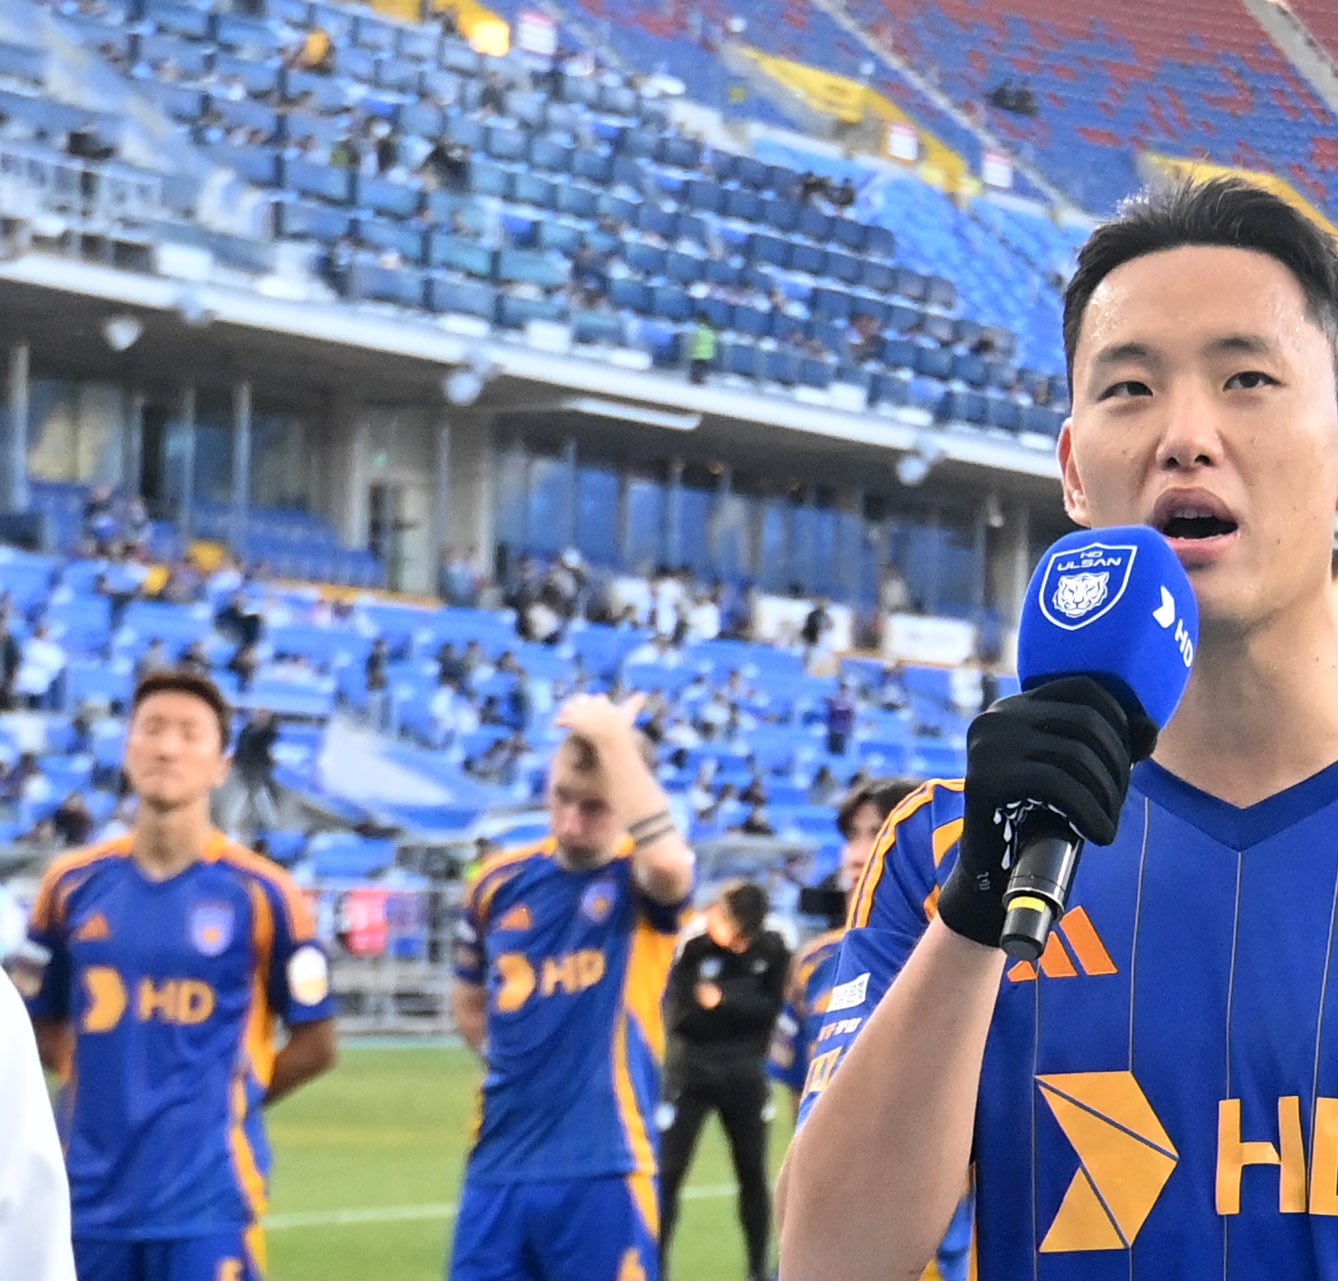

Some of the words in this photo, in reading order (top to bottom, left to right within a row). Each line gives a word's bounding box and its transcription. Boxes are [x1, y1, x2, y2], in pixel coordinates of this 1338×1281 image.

[1057, 557, 1122, 571] ULSAN
[1080, 551, 1103, 559] HD
[1174, 618, 1194, 668] HD
[541, 949, 606, 996] HD
[138, 978, 215, 1025] HD
